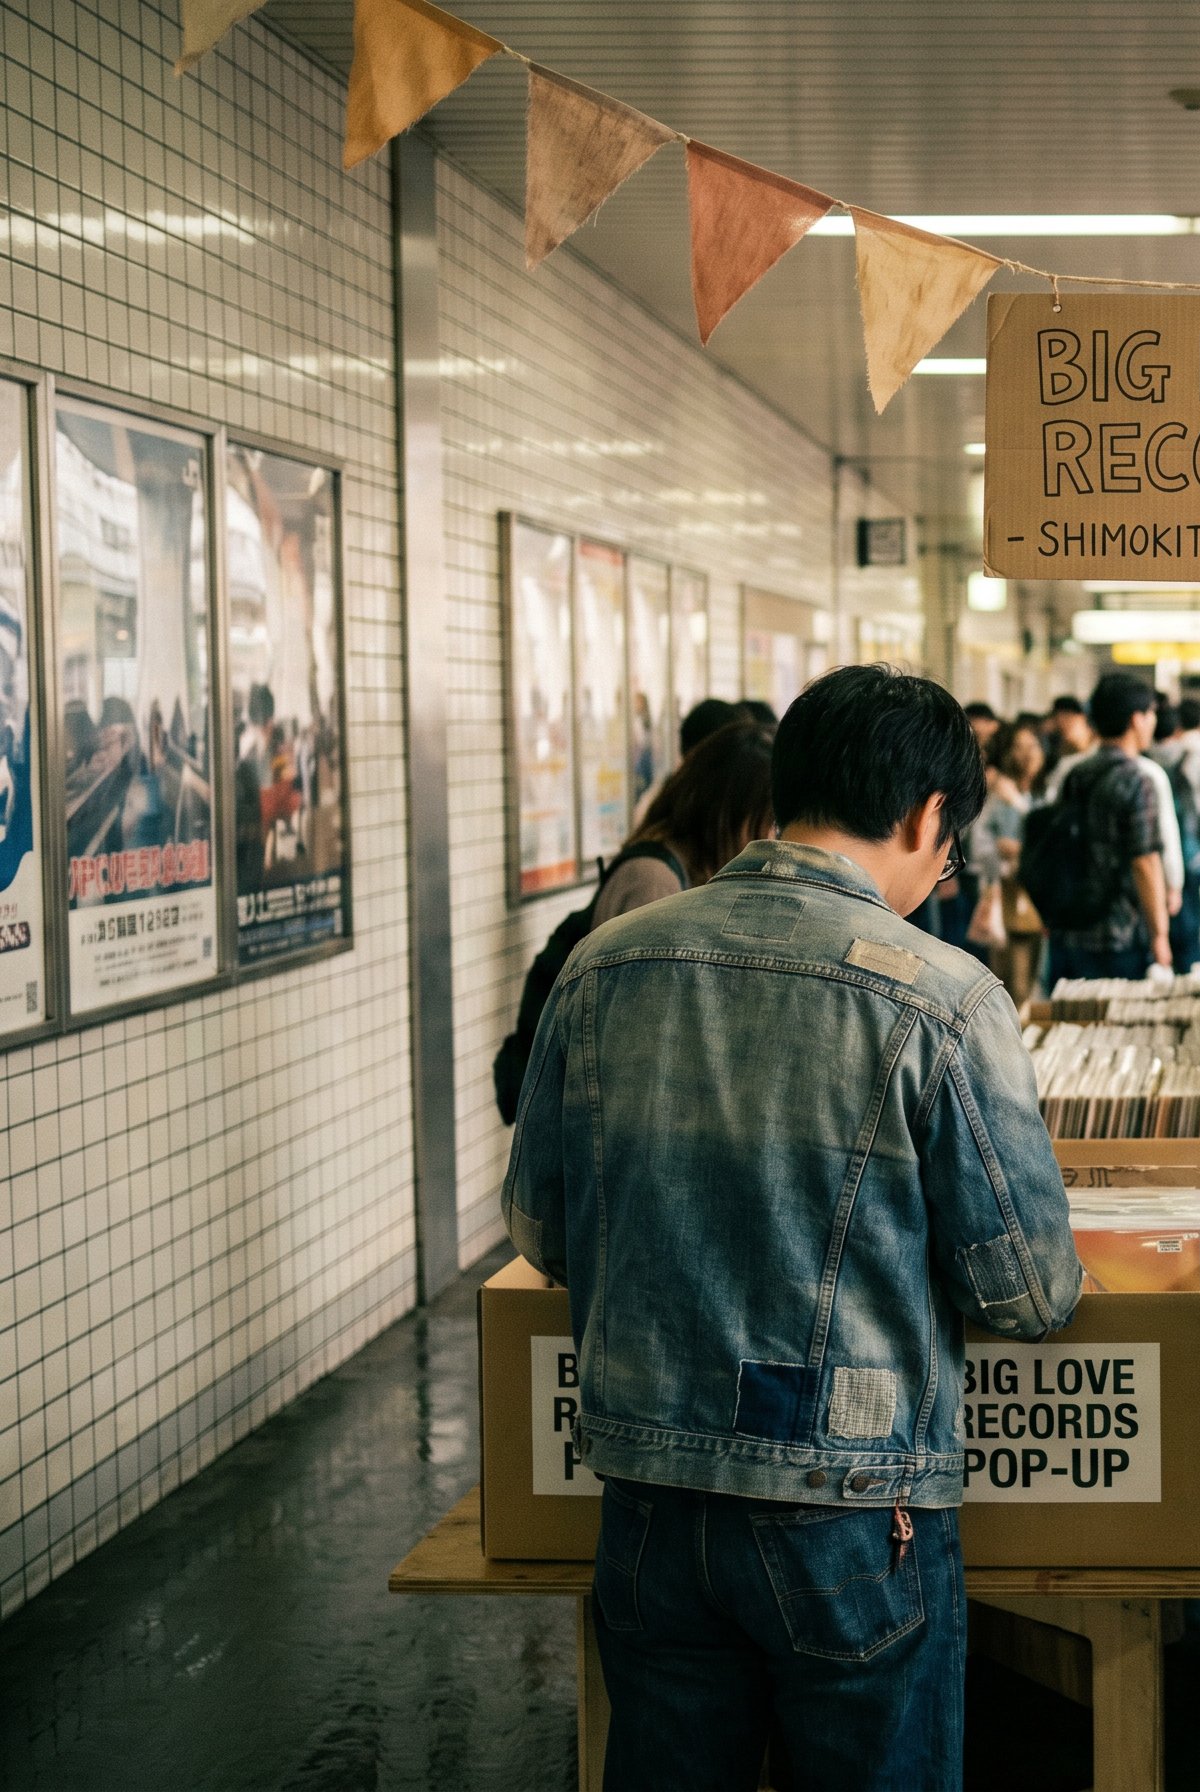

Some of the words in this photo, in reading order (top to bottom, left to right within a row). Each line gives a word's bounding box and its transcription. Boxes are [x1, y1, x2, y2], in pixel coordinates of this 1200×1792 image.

[1036, 327, 1172, 406] BIG
[1033, 1358, 1135, 1396] LOVE
[963, 1448, 1130, 1489] POP-UP
